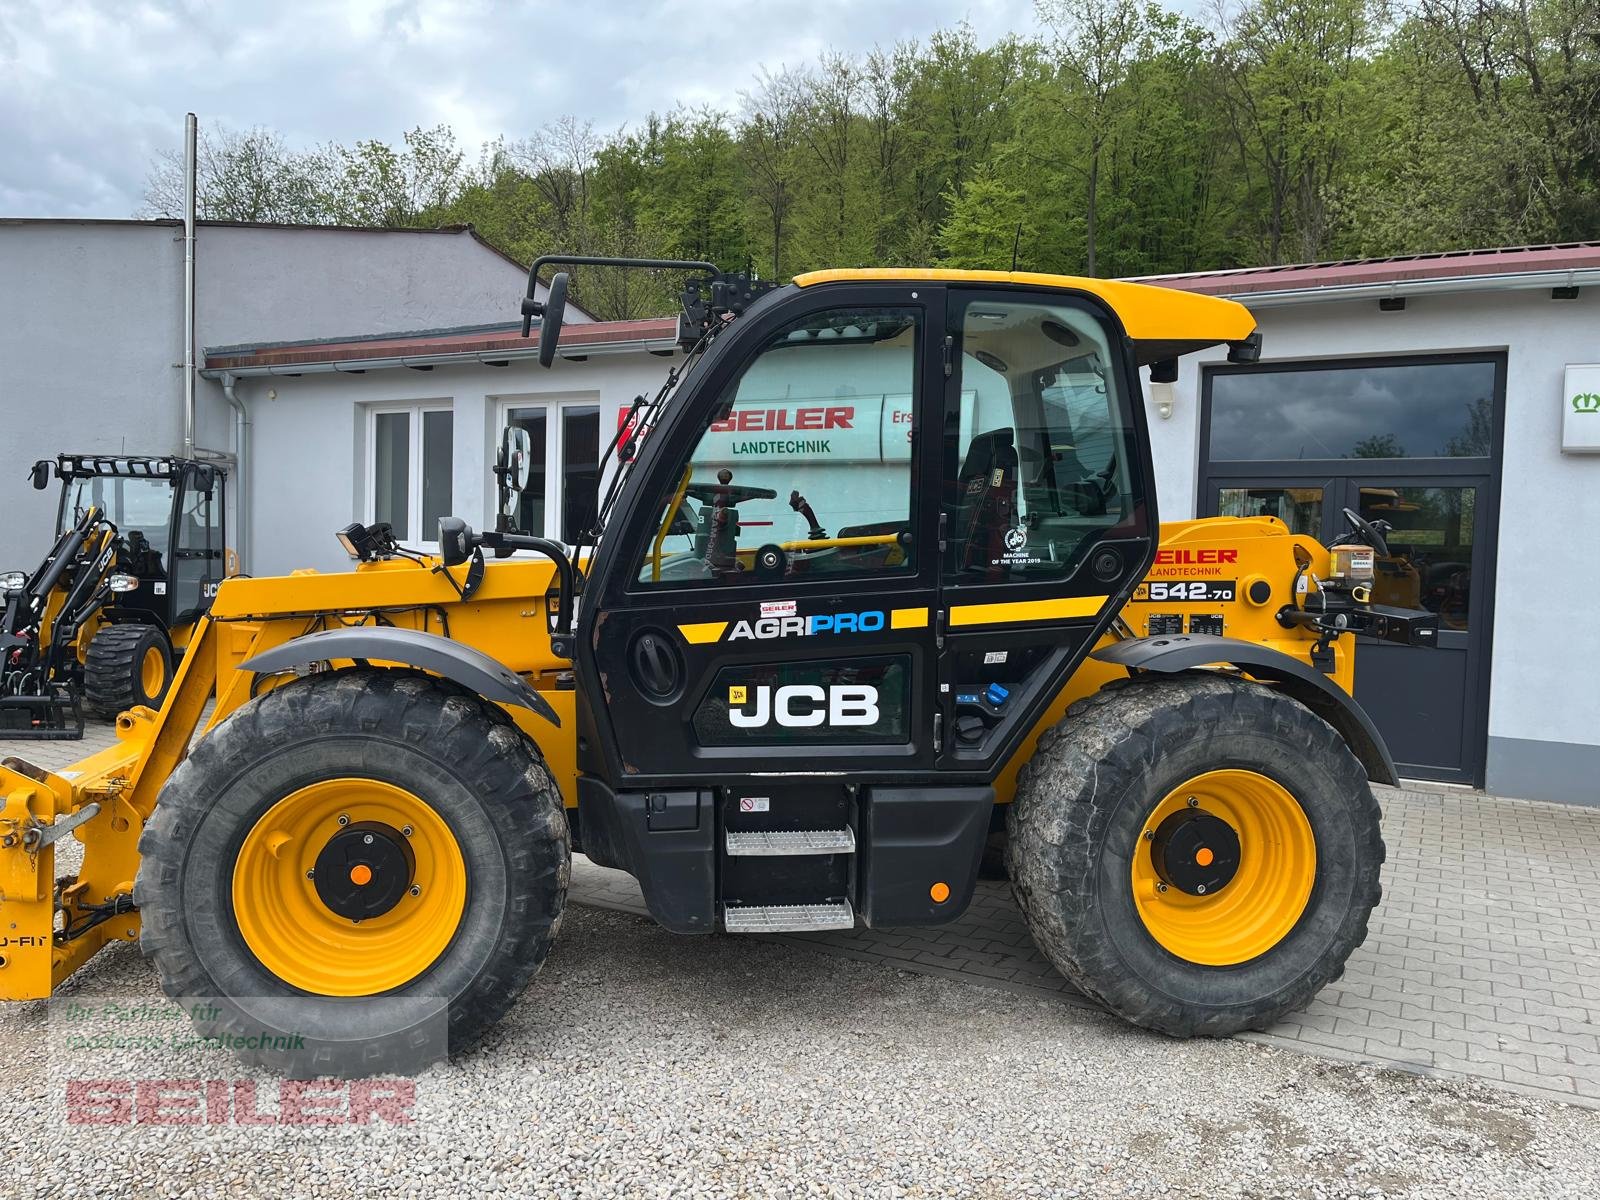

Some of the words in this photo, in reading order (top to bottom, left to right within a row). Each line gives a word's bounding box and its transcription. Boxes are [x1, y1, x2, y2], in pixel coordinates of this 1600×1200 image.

[892, 410, 912, 423] Ers
[732, 440, 831, 454] LANDTECHNIK
[98, 547, 113, 572] JCB
[1154, 550, 1237, 564] EILER
[1150, 567, 1222, 577] LANDTECHNIK
[204, 584, 220, 597] JC
[727, 610, 885, 641] AGRIPRO
[729, 685, 880, 727] JCB
